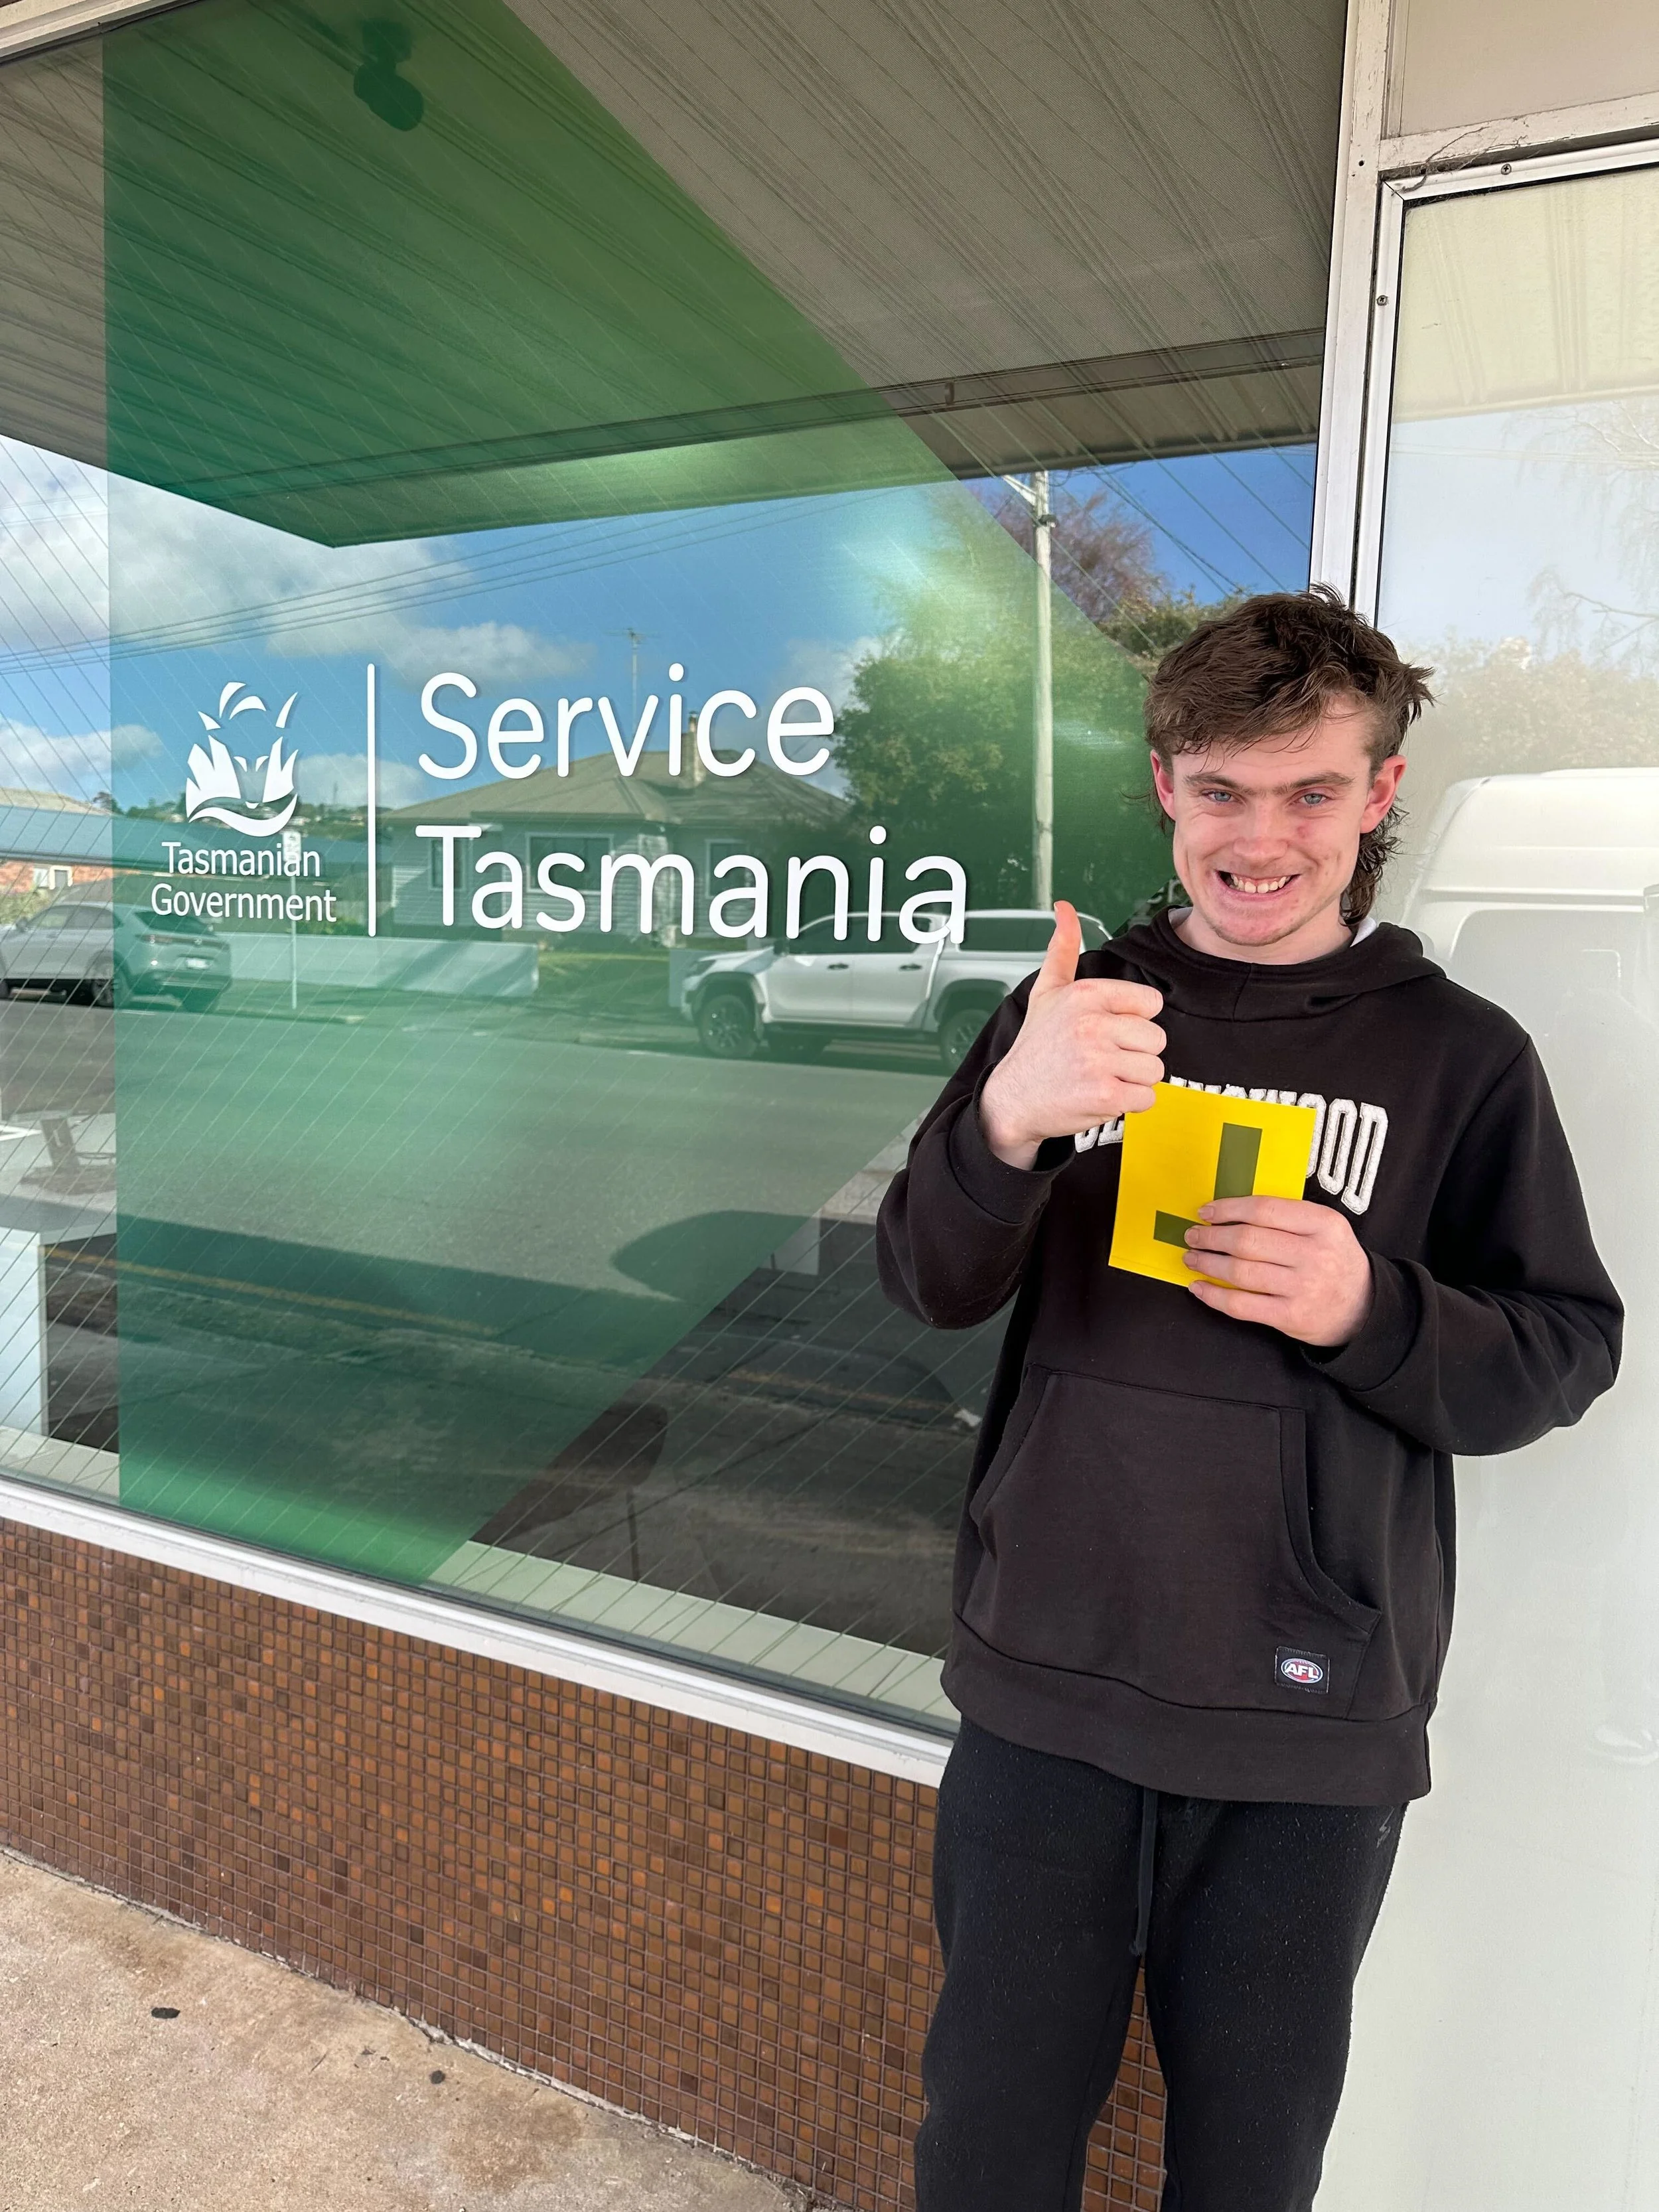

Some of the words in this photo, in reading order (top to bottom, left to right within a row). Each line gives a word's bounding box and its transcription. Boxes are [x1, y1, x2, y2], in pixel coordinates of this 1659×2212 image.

[418, 662, 836, 780] Service
[161, 841, 321, 877] Tasmanian
[151, 883, 337, 923] Government
[415, 825, 968, 945] Tasmania
[1284, 1662, 1319, 1680] AFL
